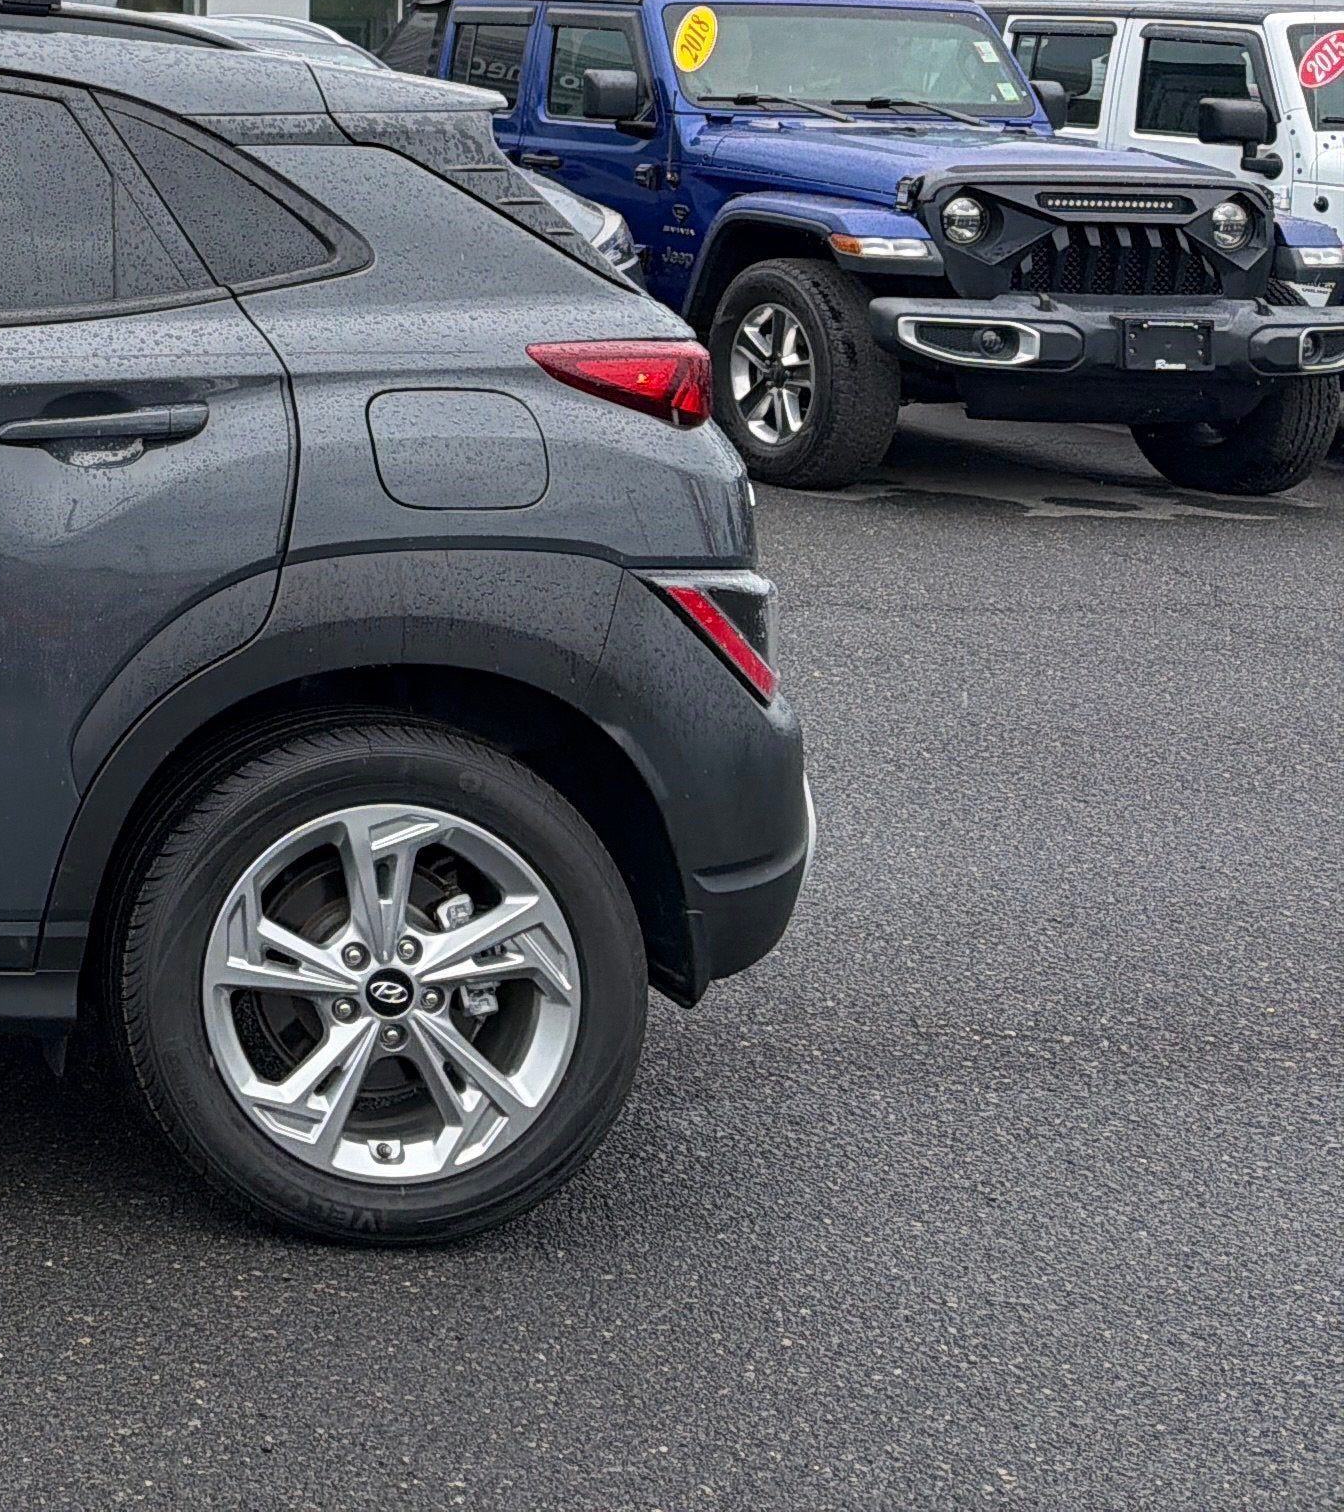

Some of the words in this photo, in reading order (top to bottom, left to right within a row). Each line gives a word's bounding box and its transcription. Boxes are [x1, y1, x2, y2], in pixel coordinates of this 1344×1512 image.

[680, 13, 710, 63] 2018
[1306, 34, 1344, 82] 2015
[661, 246, 694, 268] Jeep
